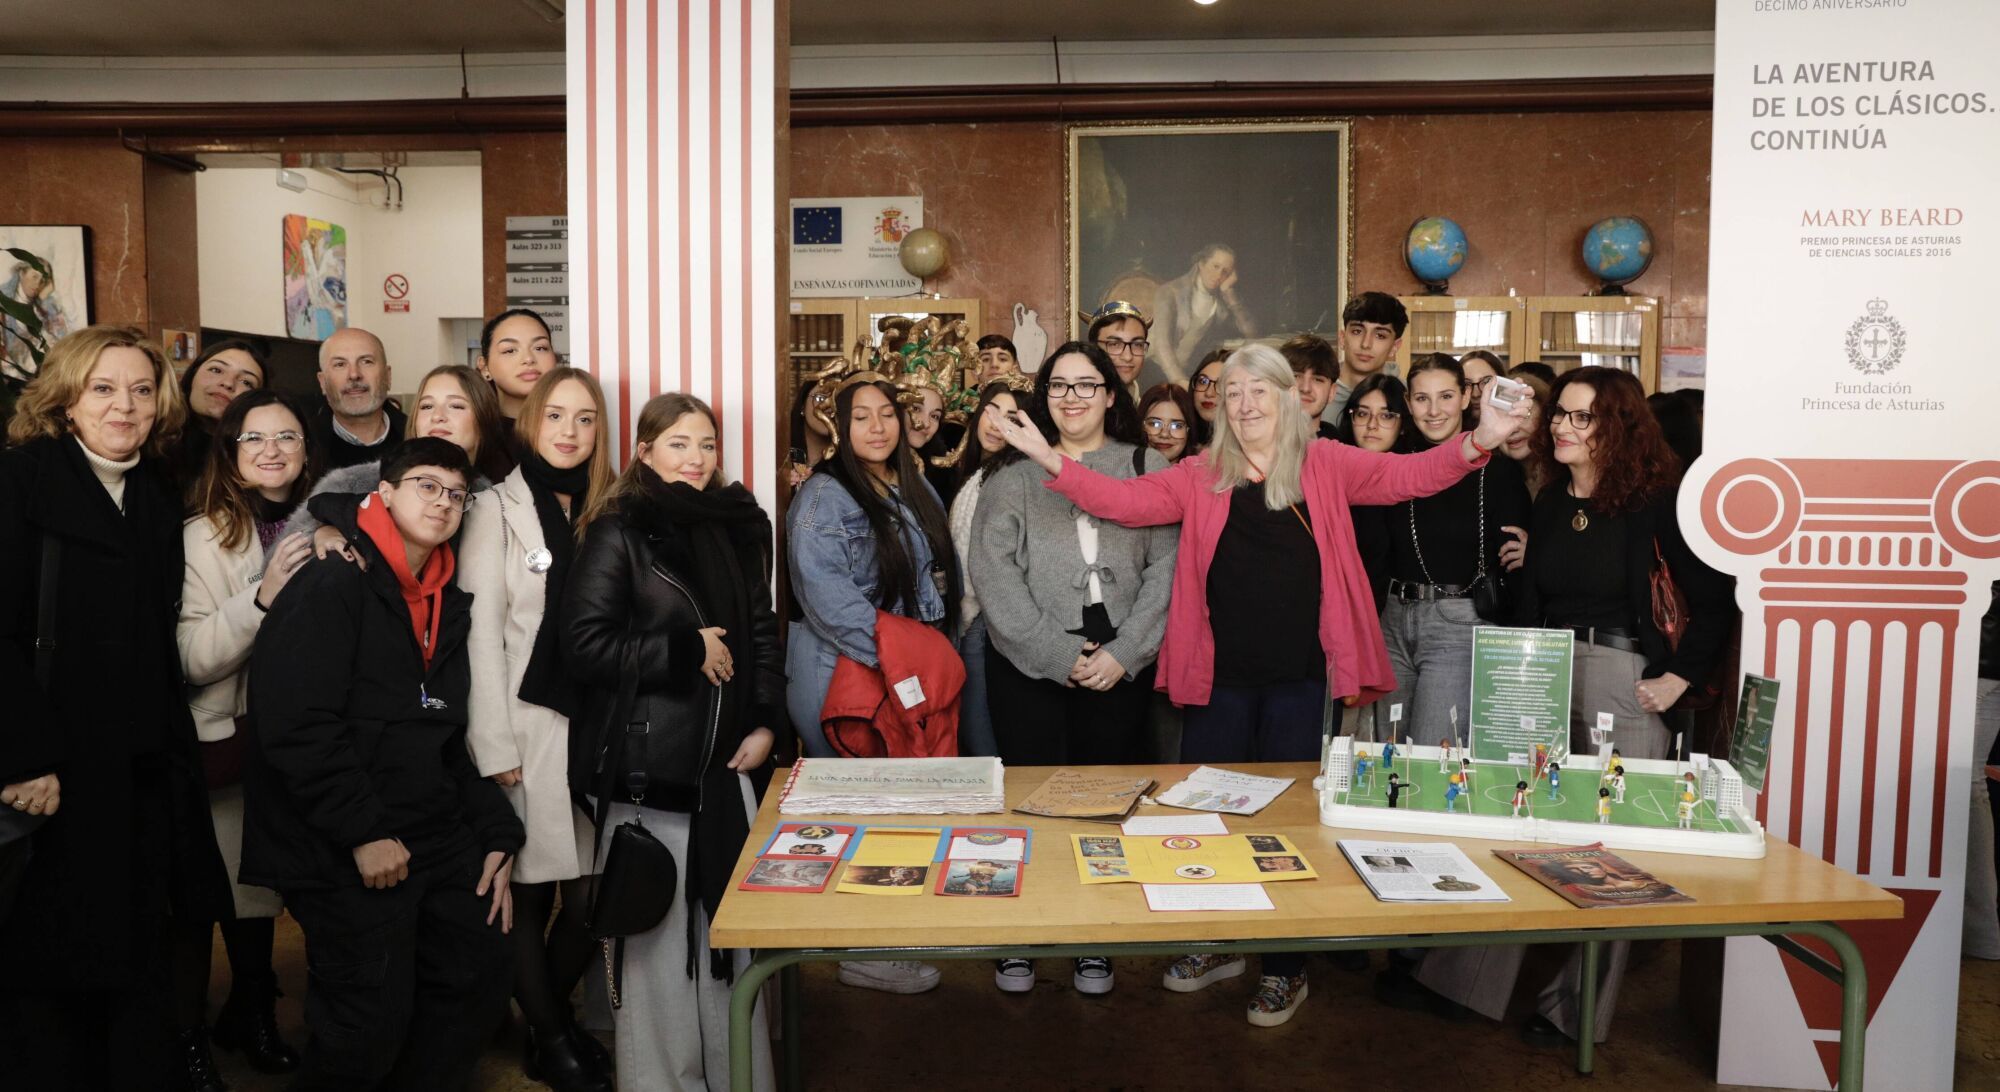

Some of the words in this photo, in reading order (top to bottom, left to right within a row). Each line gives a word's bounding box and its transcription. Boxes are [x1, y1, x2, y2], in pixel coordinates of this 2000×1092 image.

[1753, 64, 1784, 85] LA
[1793, 60, 1935, 84] AVENTURA
[1752, 97, 1786, 118] DE
[1796, 96, 1845, 117] LOS
[1750, 124, 1888, 151] CONTINÚA
[1801, 208, 1872, 227] MARY
[1880, 208, 1964, 227] BEARD
[1800, 237, 1839, 246] PREMIO
[1842, 236, 1892, 246] PRINCESA
[1895, 236, 1909, 245] DE
[1911, 236, 1962, 245] ASTURIAS
[1809, 249, 1822, 257] DE
[1825, 249, 1871, 257] CIENCIAS
[1874, 249, 1923, 257] SOCIALES
[1925, 248, 1952, 257] 2016
[794, 278, 846, 290] ENSEÑANZAS
[848, 279, 917, 289] COFINANCIADAS
[1834, 381, 1912, 394] Fundación
[1801, 398, 1860, 410] Princesa
[1865, 398, 1882, 410] de
[1886, 398, 1945, 411] Asturias
